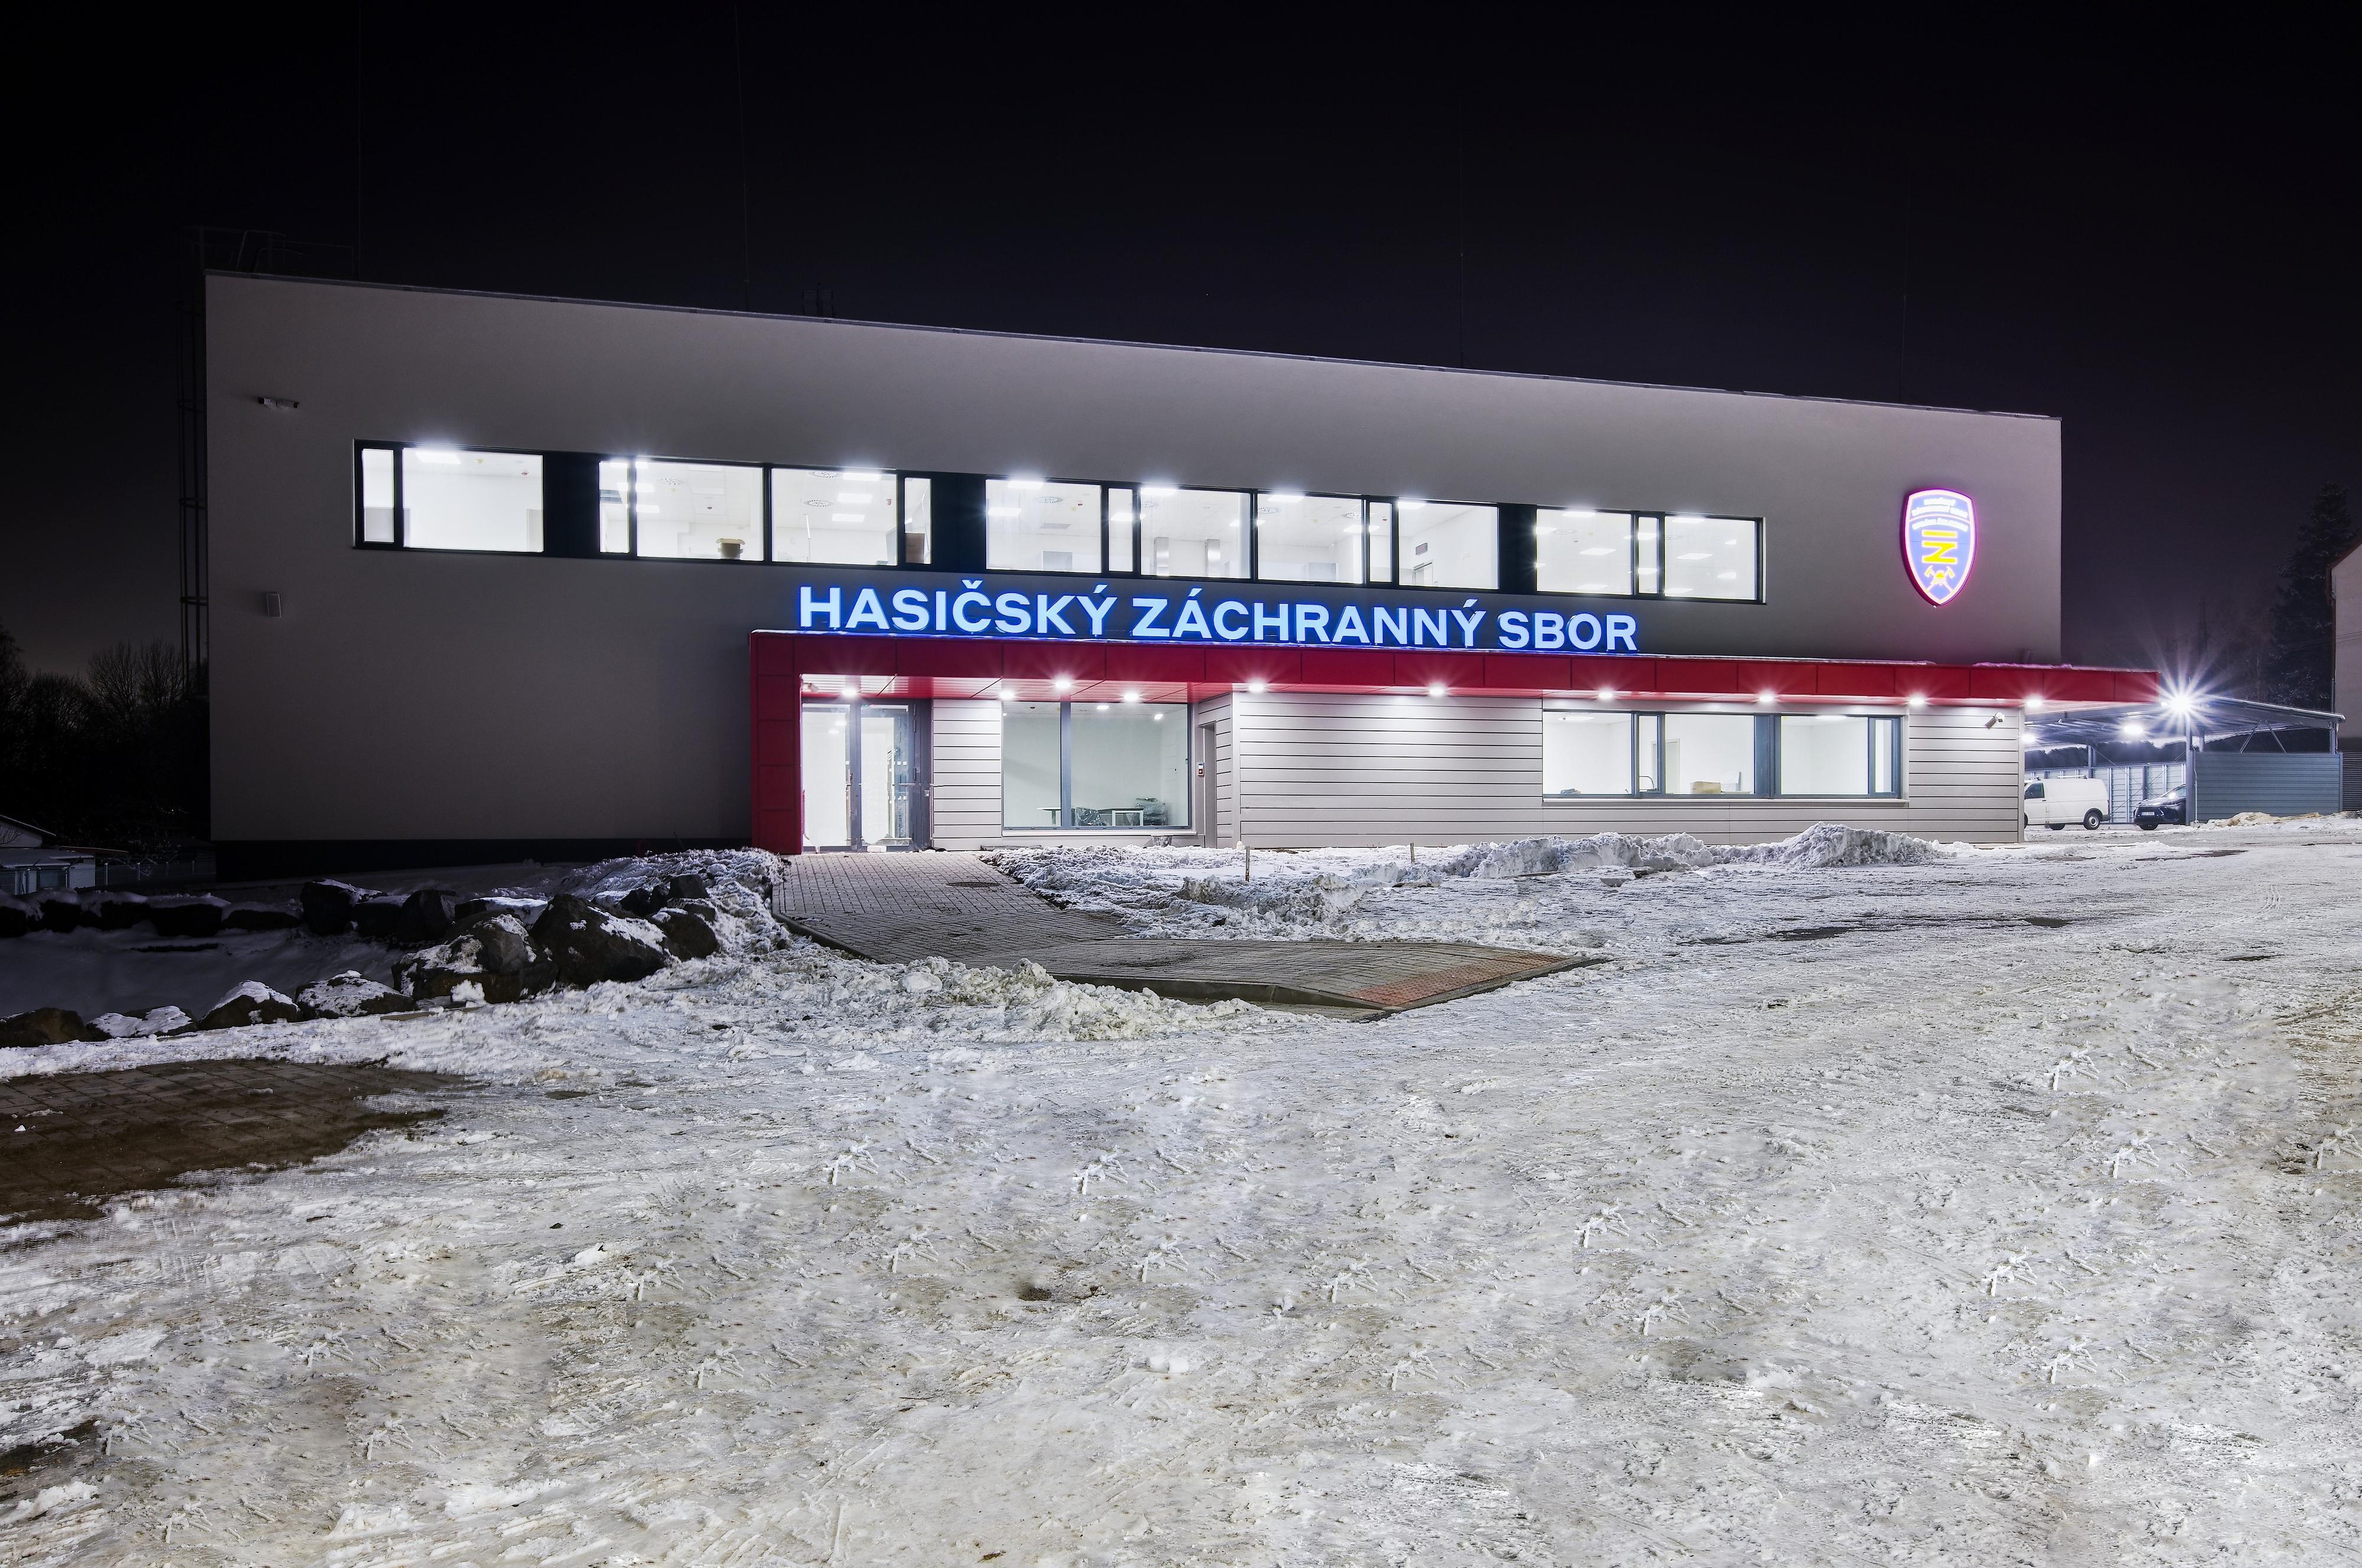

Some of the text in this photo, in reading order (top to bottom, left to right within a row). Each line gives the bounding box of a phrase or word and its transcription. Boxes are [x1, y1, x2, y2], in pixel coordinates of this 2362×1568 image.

[800, 579, 1639, 651] HASIČSKÝ ZÁCHRANNÝ SBOR
